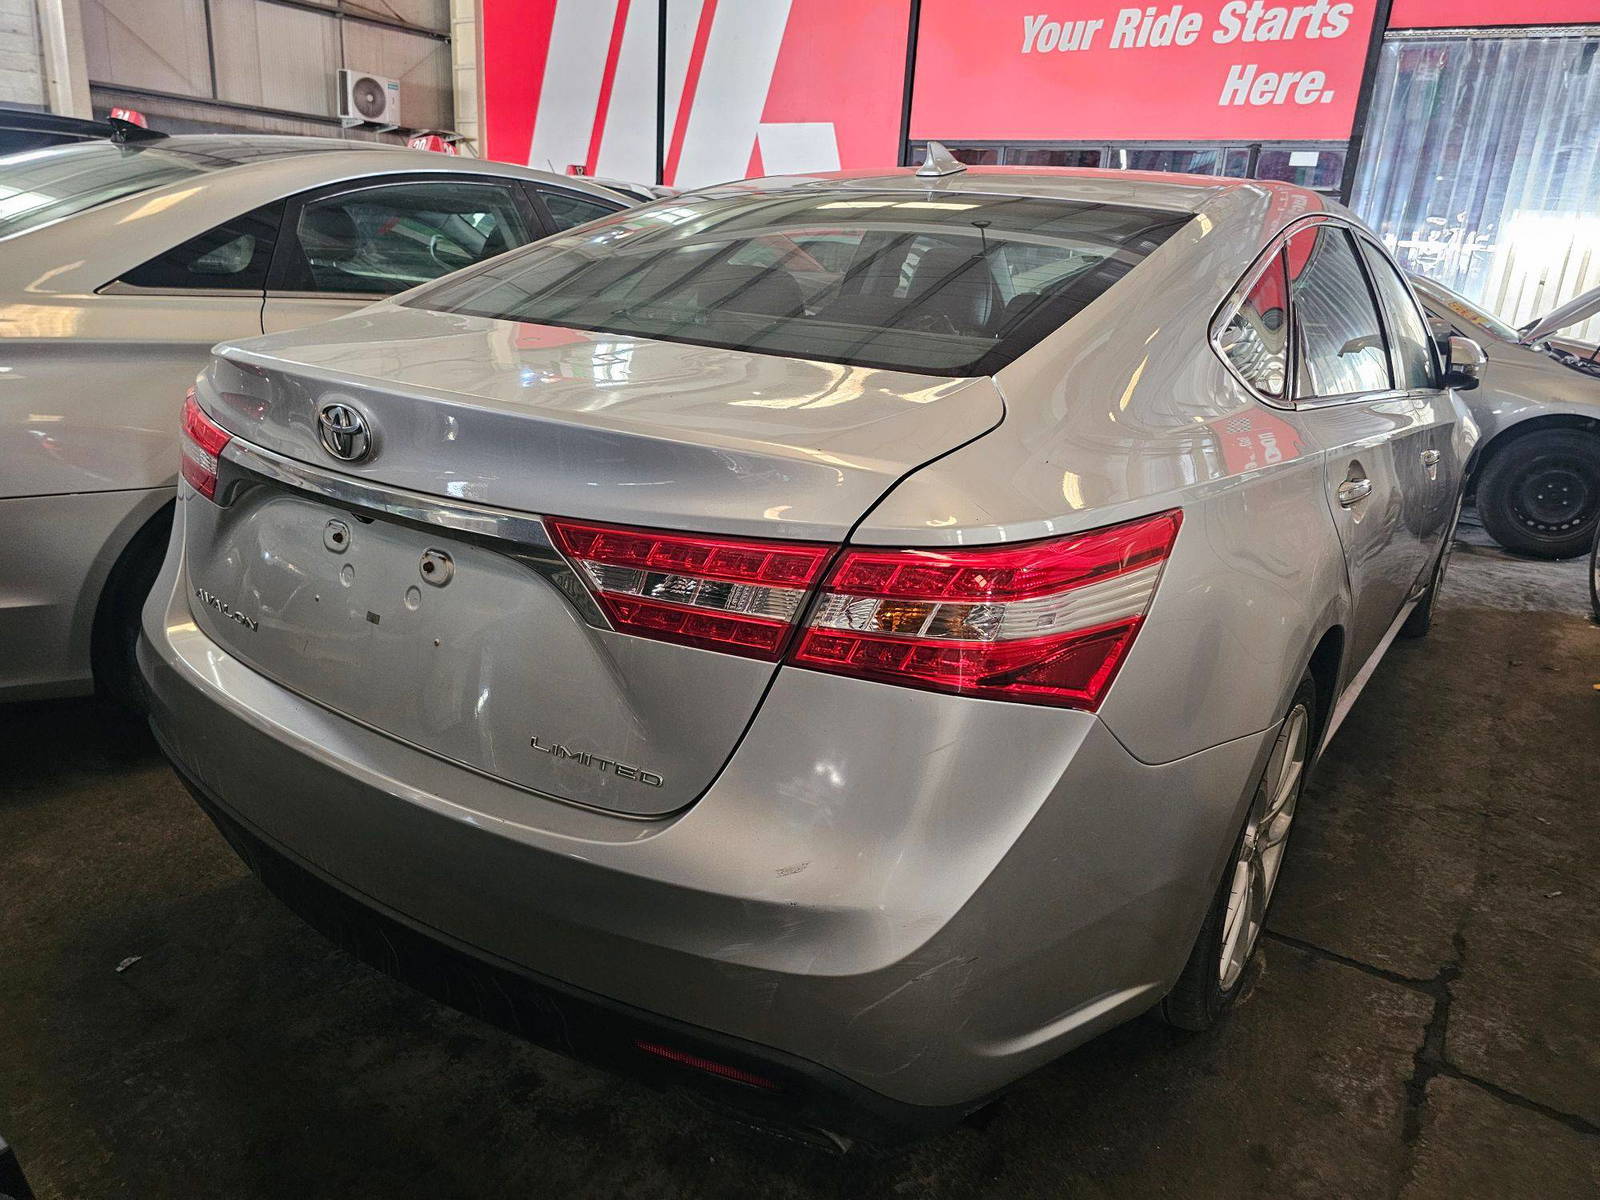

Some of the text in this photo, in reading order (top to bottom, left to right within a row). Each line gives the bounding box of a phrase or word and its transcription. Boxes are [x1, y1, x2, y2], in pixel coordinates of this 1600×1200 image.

[1021, 0, 1353, 54] Your Ride Starts
[1218, 64, 1336, 106] Here.
[195, 588, 259, 632] AVALON
[530, 735, 664, 788] LIMITED
